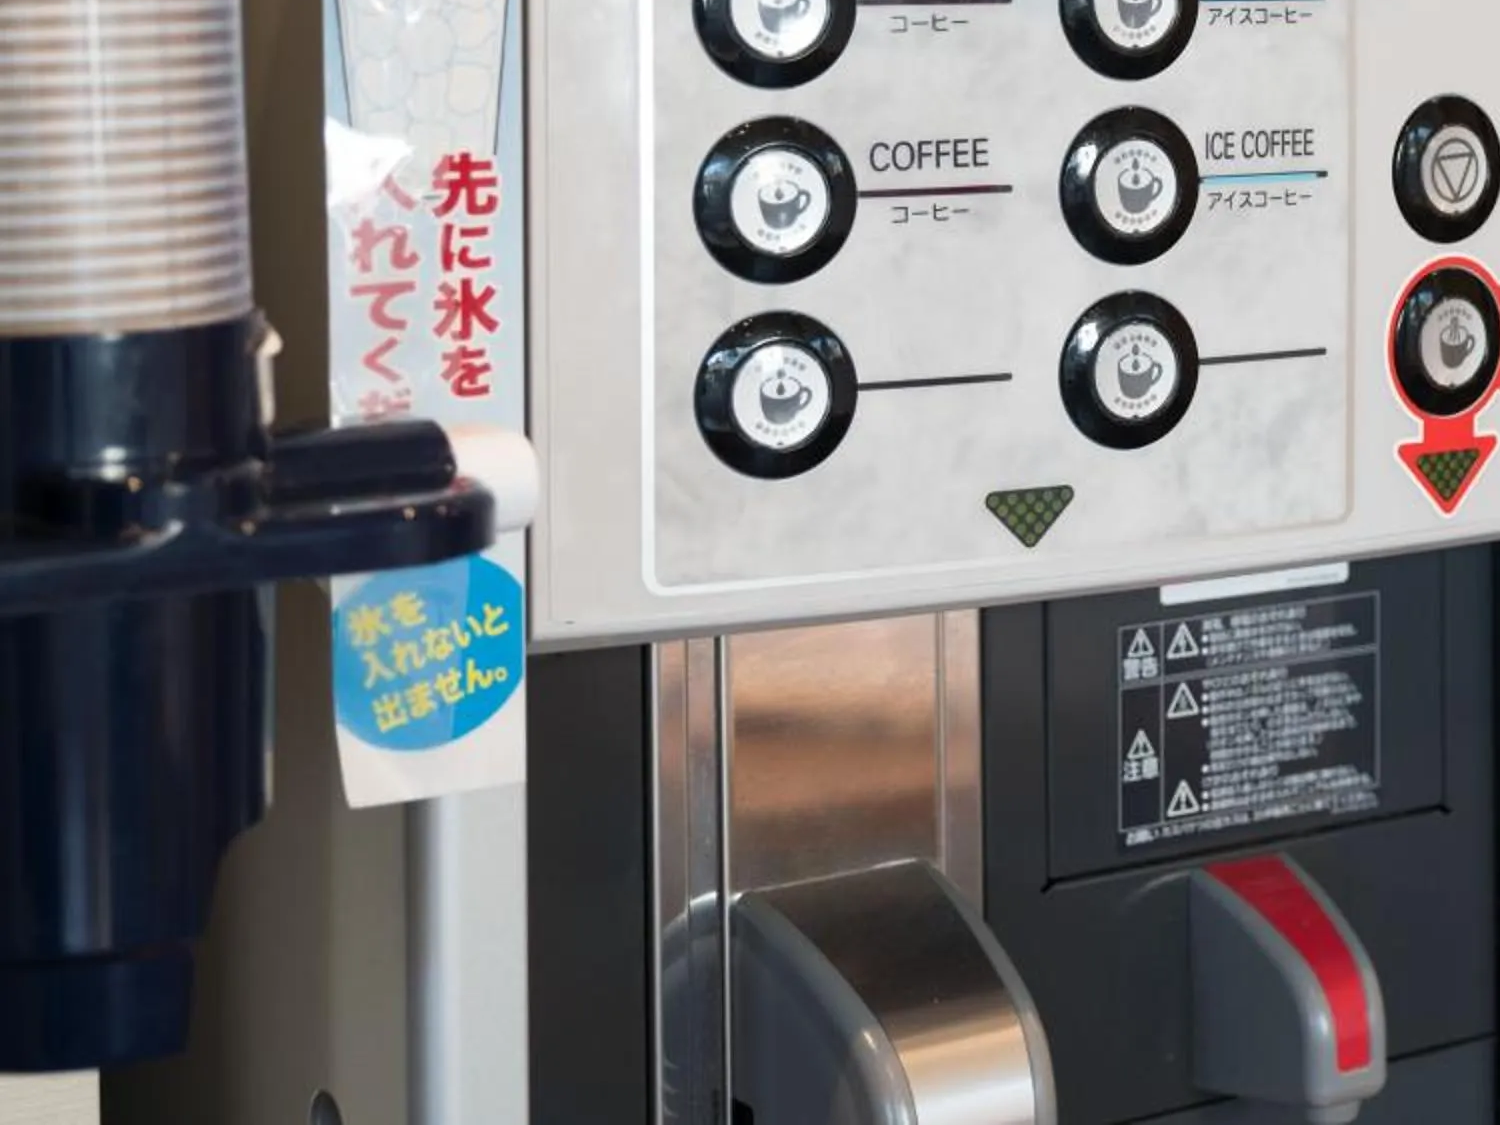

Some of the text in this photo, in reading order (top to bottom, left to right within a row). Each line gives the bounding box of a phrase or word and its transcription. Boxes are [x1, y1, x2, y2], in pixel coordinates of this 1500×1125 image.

[890, 13, 970, 33] コーヒー
[1208, 7, 1313, 26] アイスコーヒー
[869, 137, 989, 173] COFFEE
[1205, 128, 1316, 161] ICE COFFEE
[890, 203, 970, 224] コーヒー
[1207, 189, 1313, 211] アイスコーヒー
[432, 152, 500, 398] 先に氷を
[350, 591, 428, 647] 氷を
[361, 603, 510, 690] 入れないと
[371, 658, 509, 735] 出ません。
